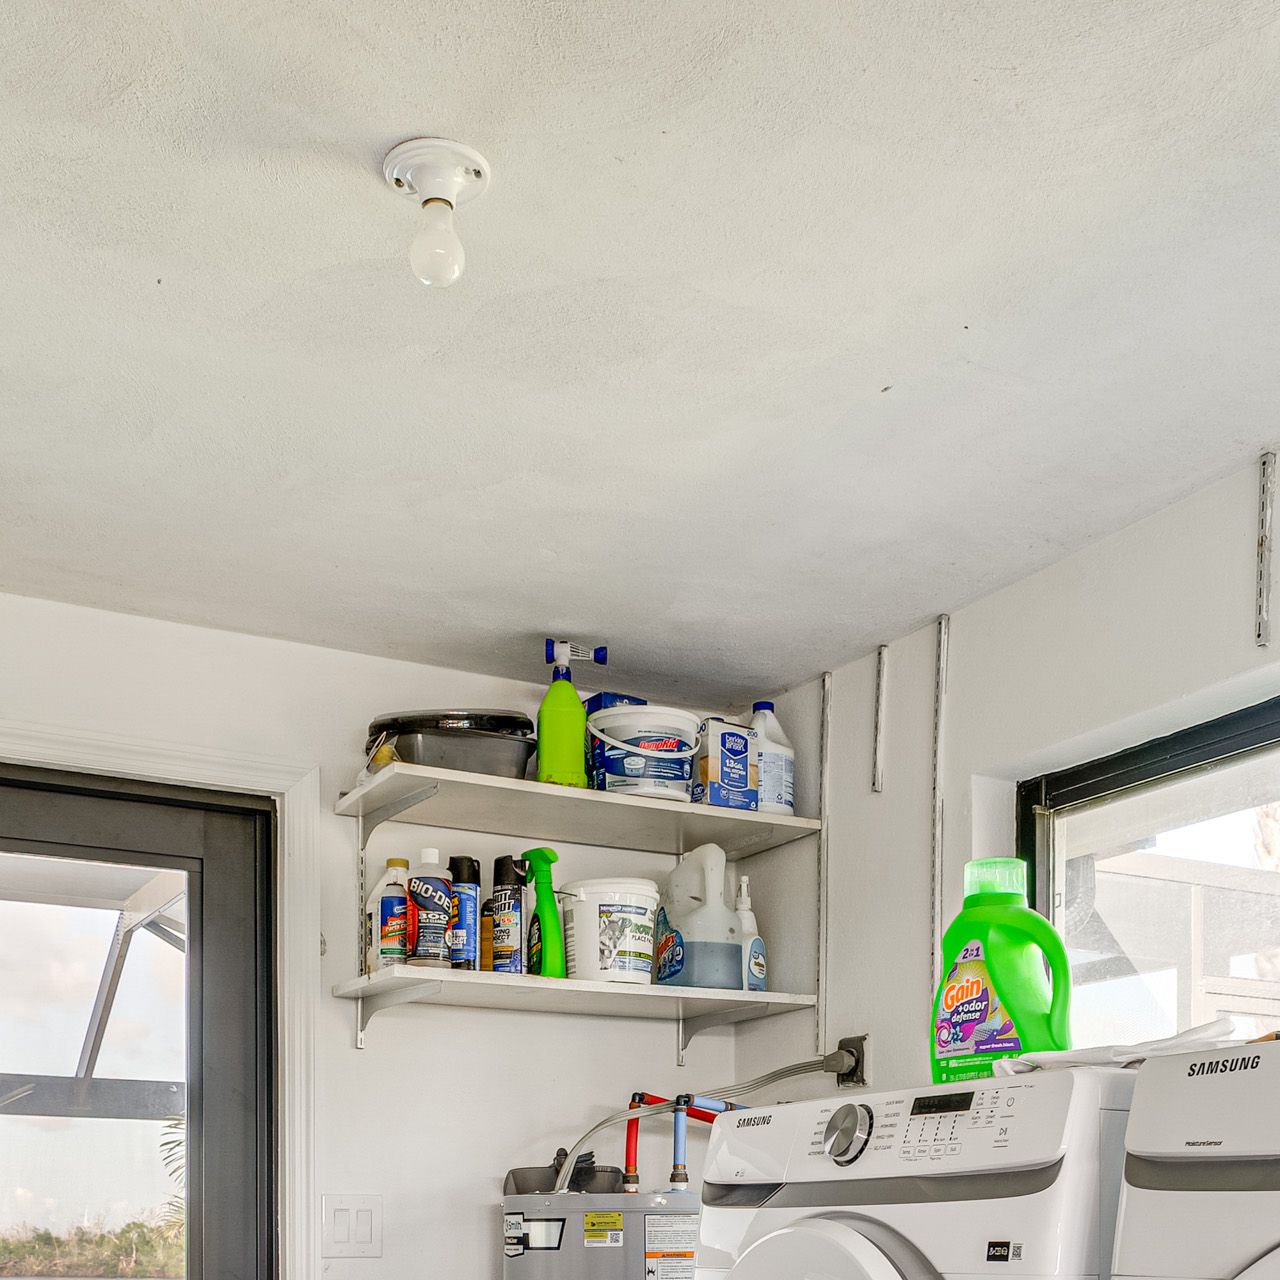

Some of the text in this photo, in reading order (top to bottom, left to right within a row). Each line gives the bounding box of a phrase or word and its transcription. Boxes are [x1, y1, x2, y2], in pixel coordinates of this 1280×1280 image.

[746, 729, 759, 739] 200
[943, 978, 982, 1013] Gain
[958, 1000, 988, 1013] +odor
[951, 1011, 981, 1023] defense
[1187, 1055, 1261, 1077] SAMSUNG
[736, 1114, 772, 1129] SAMSUNG
